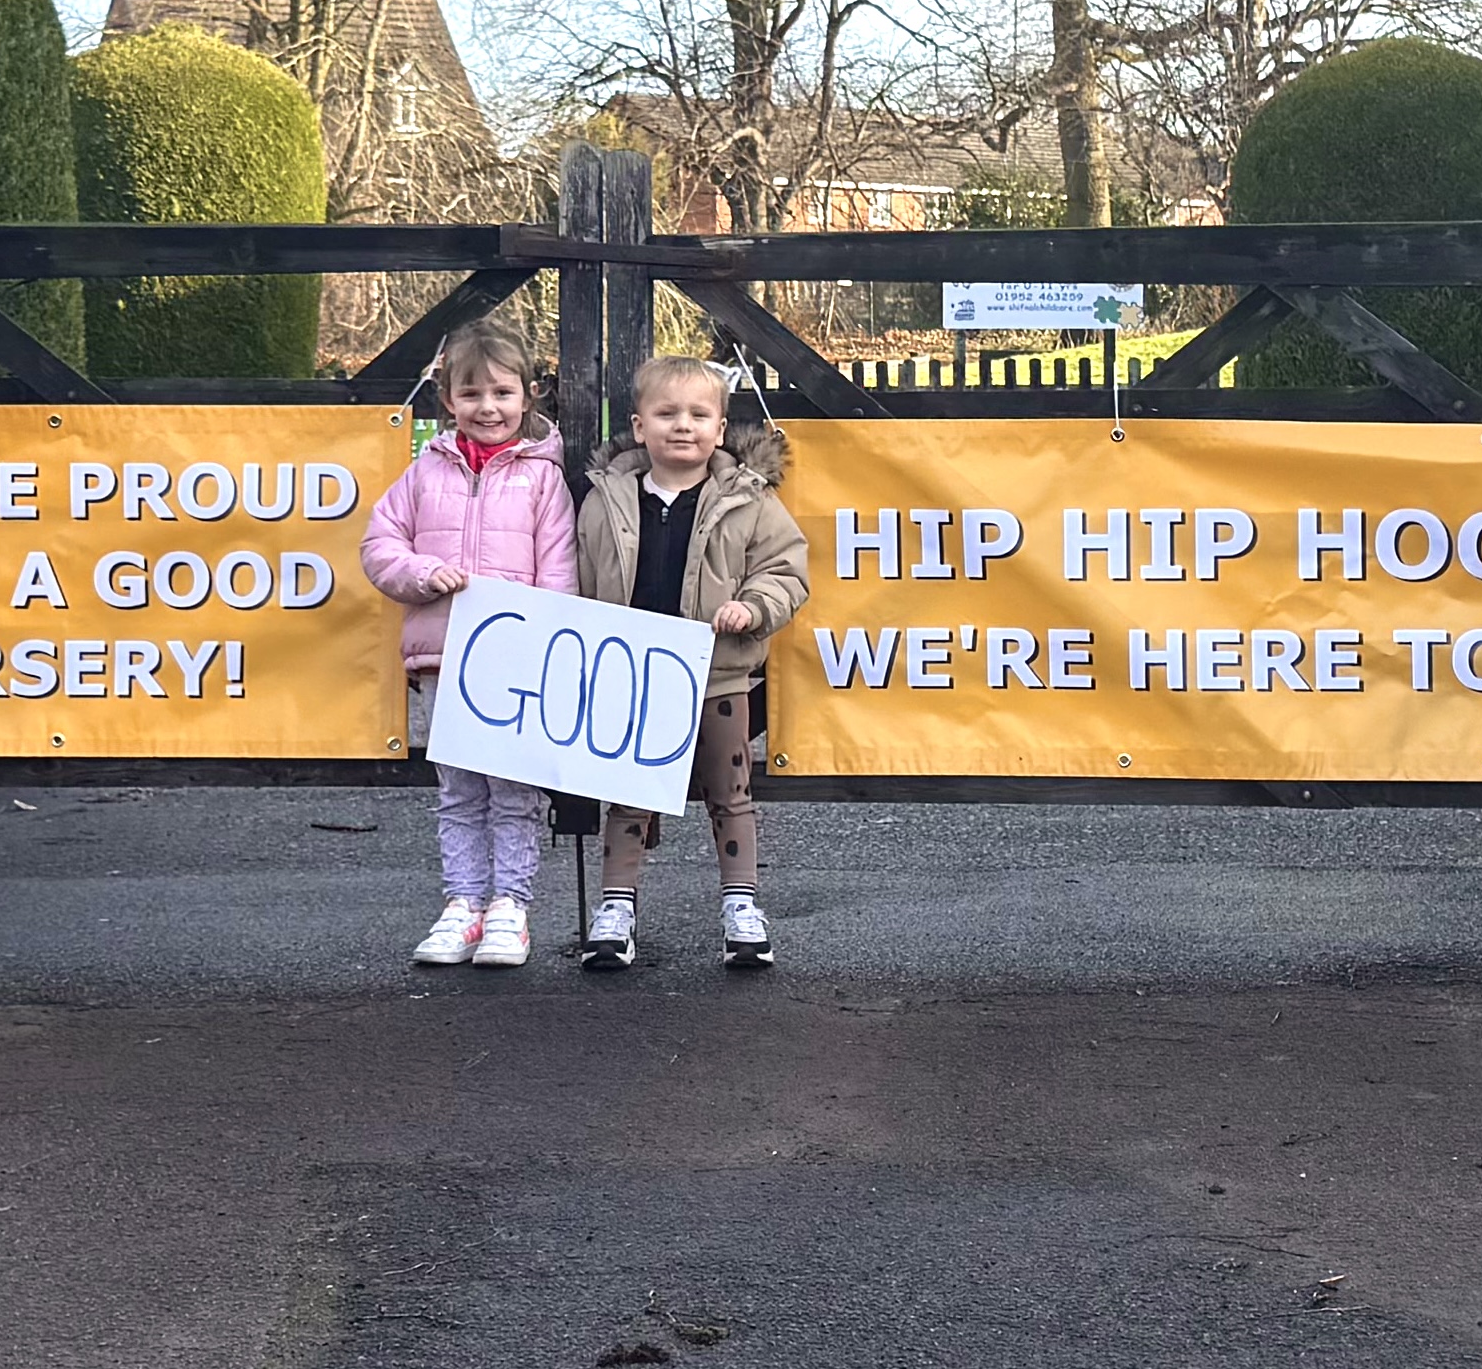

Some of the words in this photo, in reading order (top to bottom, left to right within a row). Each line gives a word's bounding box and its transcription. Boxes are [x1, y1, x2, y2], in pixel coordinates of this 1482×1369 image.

[70, 461, 359, 521] PROUD
[12, 550, 68, 609] A
[93, 549, 335, 610] GOOD
[835, 507, 1025, 581] HIP
[1063, 507, 1257, 583] HIP
[458, 611, 698, 767] GOOD
[813, 624, 1094, 690] WE'RE
[1128, 628, 1364, 694] HERE
